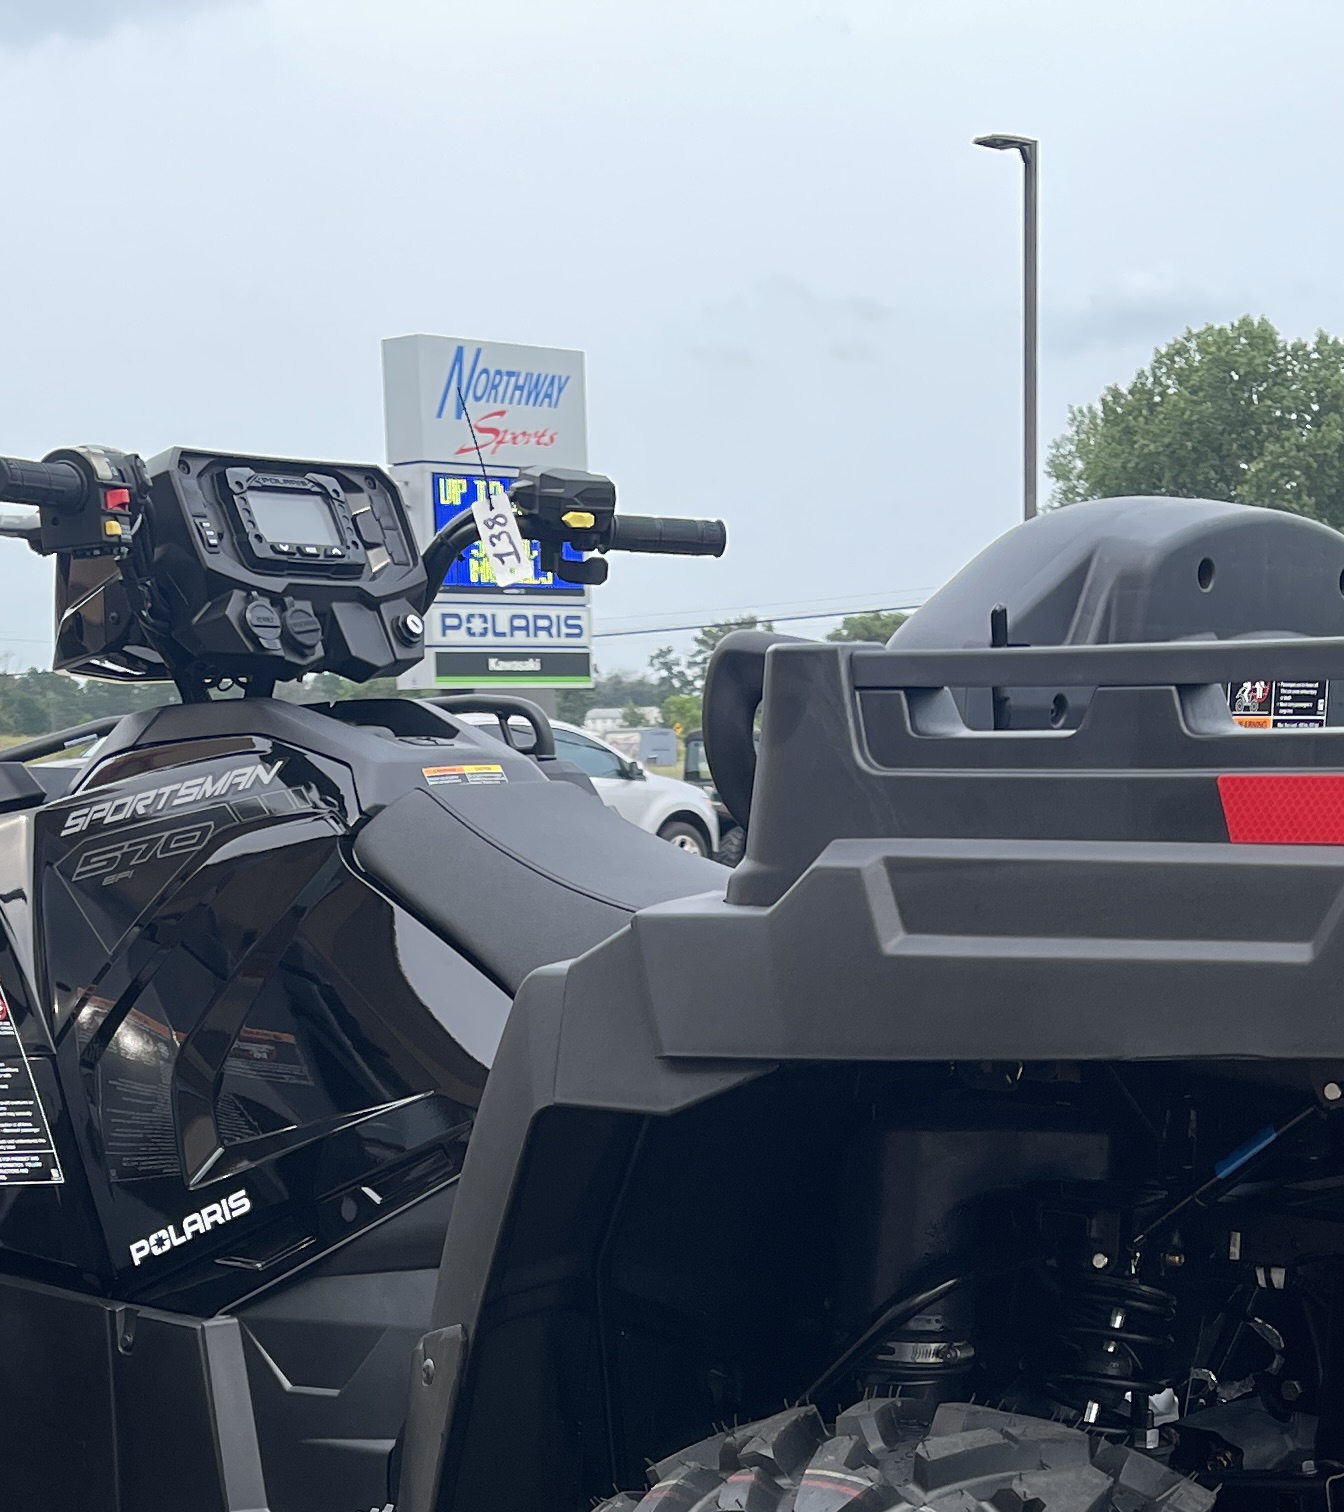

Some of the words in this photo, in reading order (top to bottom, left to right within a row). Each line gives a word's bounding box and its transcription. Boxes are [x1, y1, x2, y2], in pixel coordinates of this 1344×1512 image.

[436, 345, 571, 420] NORTHWAY
[454, 409, 559, 455] Sports
[439, 478, 467, 505] UP
[440, 613, 583, 638] POLARIS
[60, 760, 284, 837] SPORTSMAN
[71, 821, 214, 882] 570
[129, 1189, 251, 1266] POLARIS
